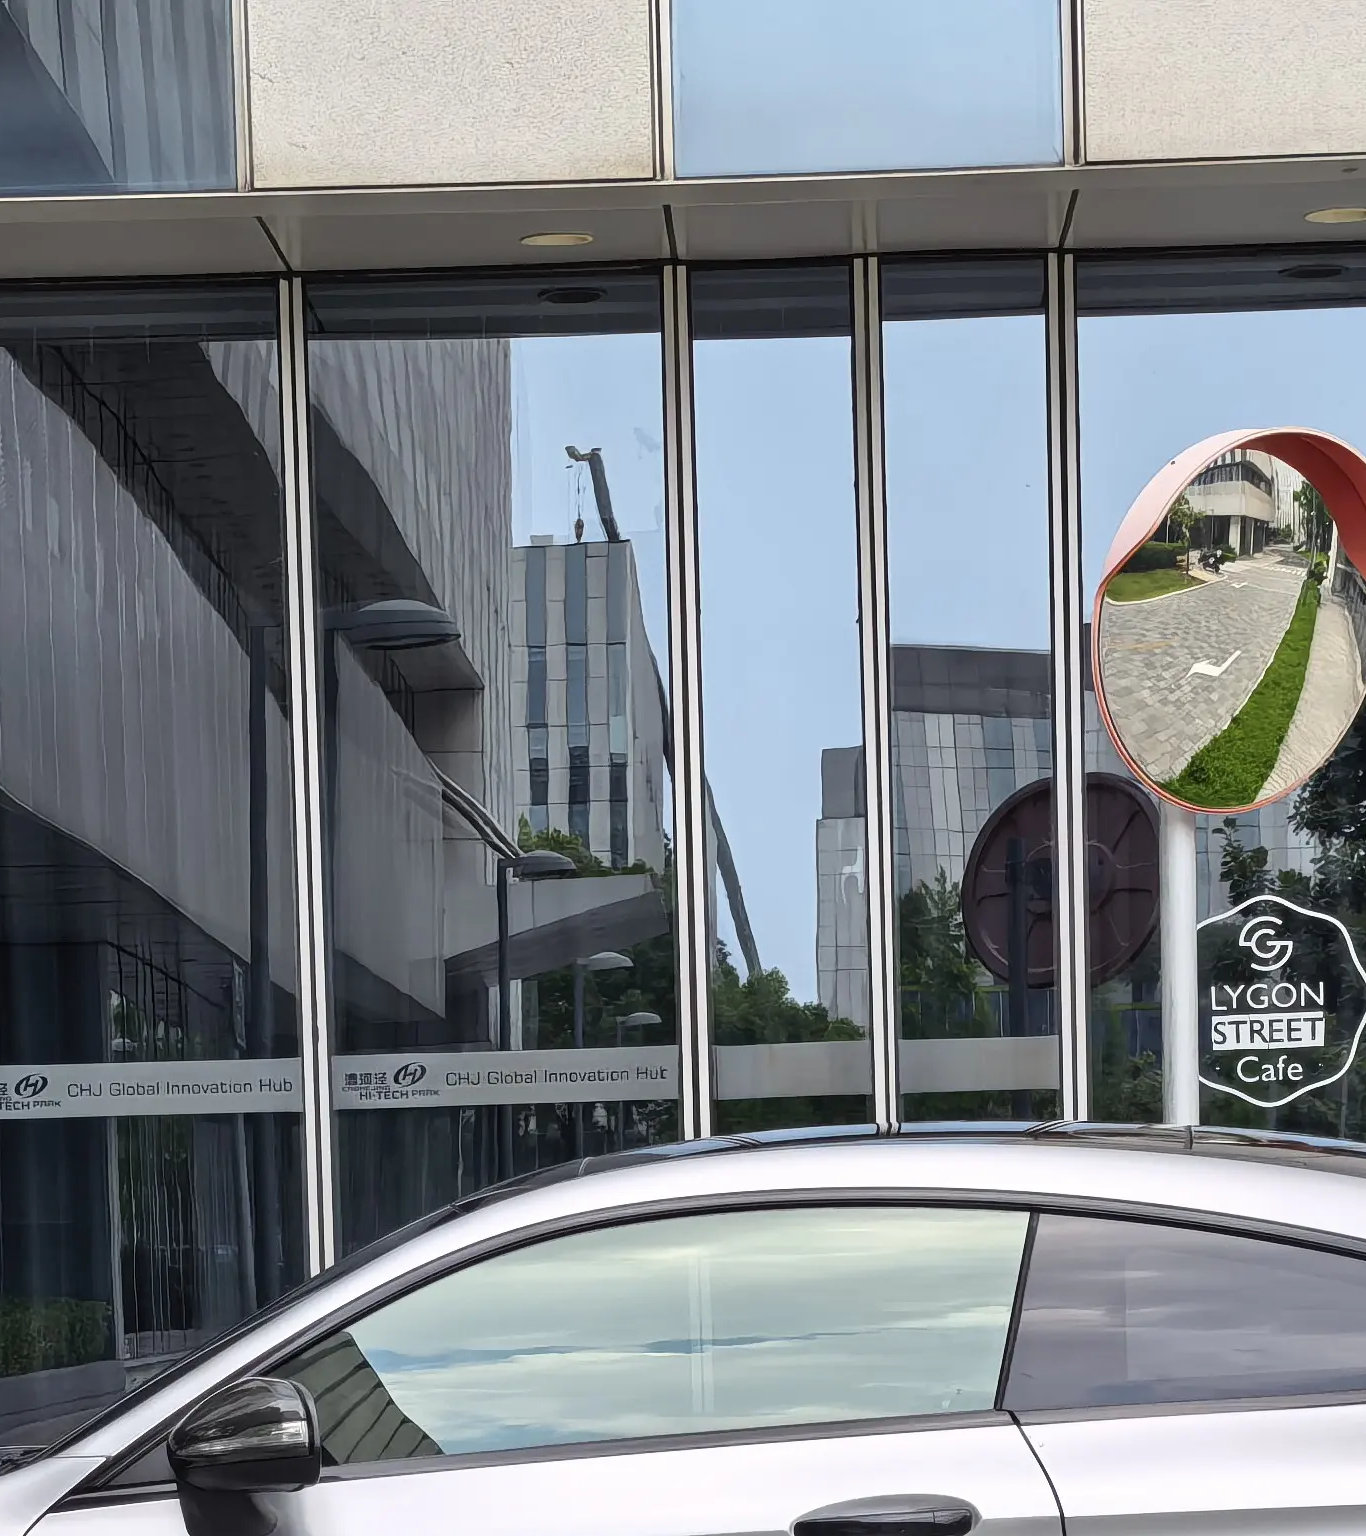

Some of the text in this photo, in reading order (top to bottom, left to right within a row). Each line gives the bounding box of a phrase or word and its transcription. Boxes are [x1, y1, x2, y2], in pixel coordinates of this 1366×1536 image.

[1211, 982, 1324, 1011] LYGON
[1213, 1017, 1324, 1045] STREET
[445, 1071, 481, 1086] CHJ
[487, 1070, 537, 1085] Global
[544, 1069, 629, 1083] Innovation
[1237, 1055, 1303, 1082] Cafe
[67, 1077, 293, 1098] CHJ Global Innovation Hub
